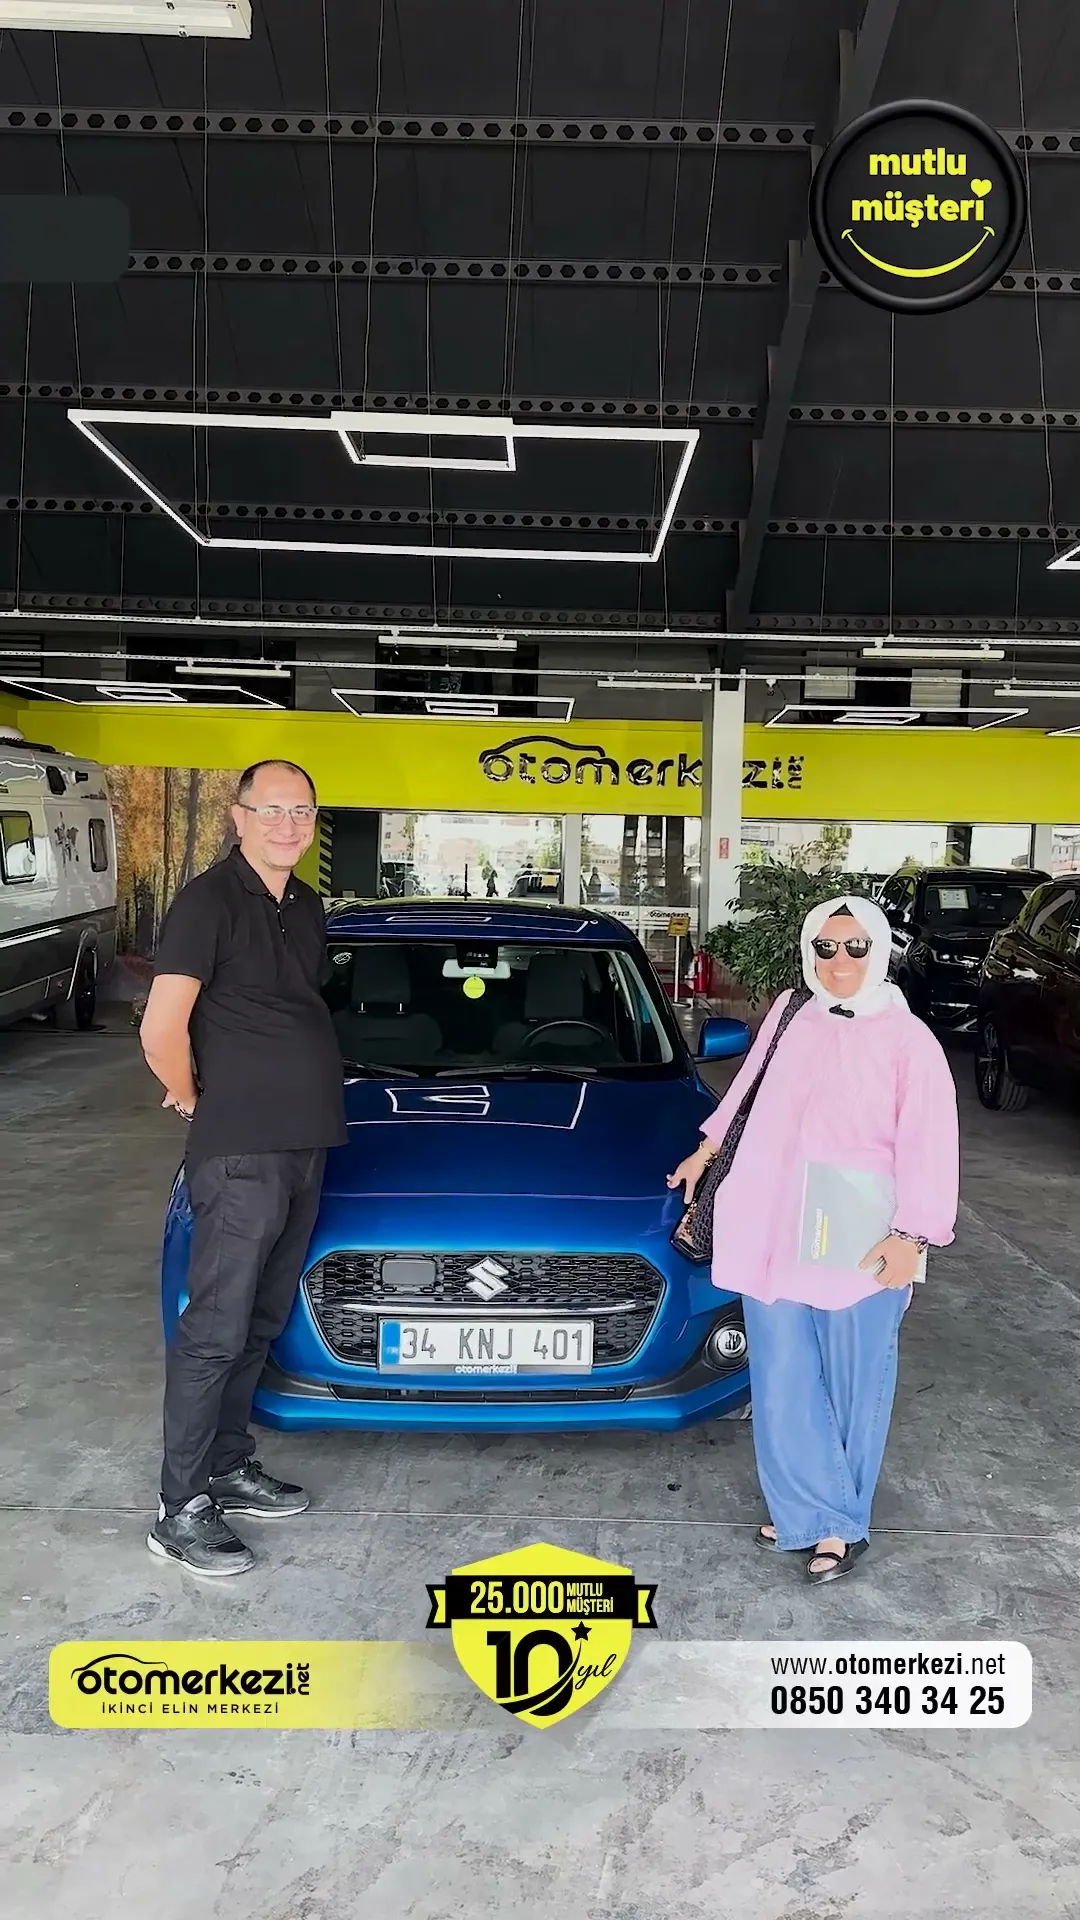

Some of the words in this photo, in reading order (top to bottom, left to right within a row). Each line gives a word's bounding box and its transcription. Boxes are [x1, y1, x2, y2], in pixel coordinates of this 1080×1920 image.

[402, 1328, 436, 1359] 34
[459, 1328, 513, 1360] KNJ
[533, 1329, 582, 1360] 401
